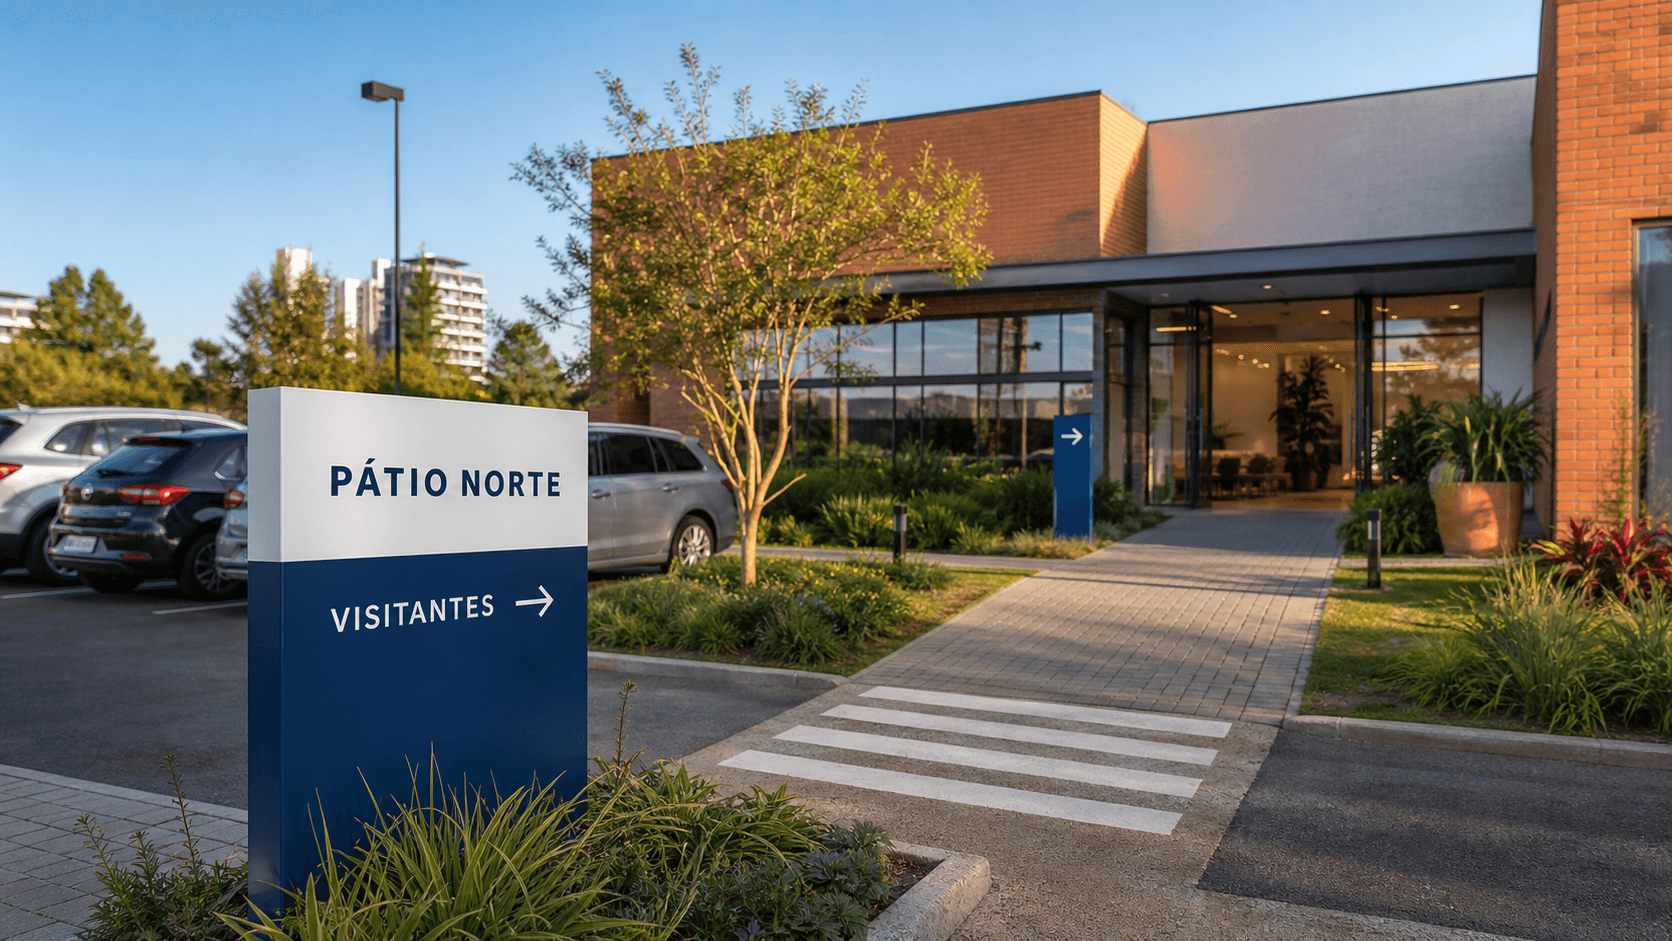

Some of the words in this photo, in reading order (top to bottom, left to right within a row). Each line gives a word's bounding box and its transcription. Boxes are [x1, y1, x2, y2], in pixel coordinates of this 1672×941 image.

[330, 457, 448, 497] PÁTIO
[461, 469, 561, 497] NORTE
[330, 594, 494, 633] VISITANTES
